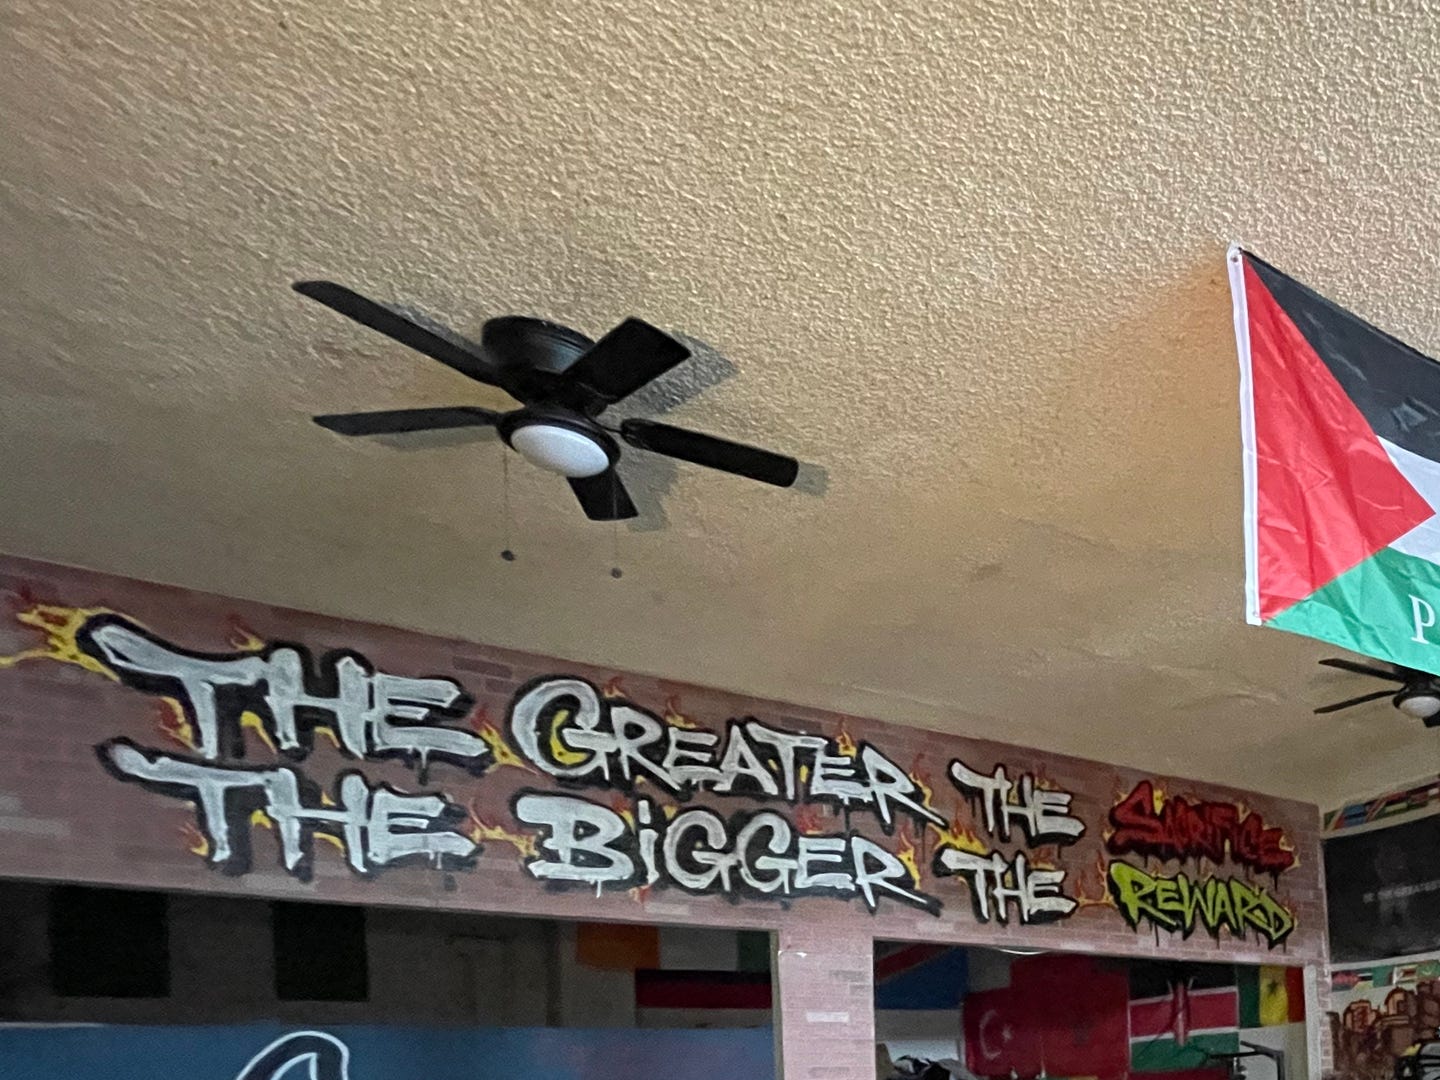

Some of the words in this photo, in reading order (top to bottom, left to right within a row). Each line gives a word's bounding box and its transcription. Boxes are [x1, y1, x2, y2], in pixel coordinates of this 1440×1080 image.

[88, 618, 494, 764] THE
[510, 677, 949, 829] GREATER
[949, 759, 1087, 842] THE
[106, 738, 483, 874] THE
[940, 849, 1078, 921] THE
[1109, 861, 1293, 942] REWARD
